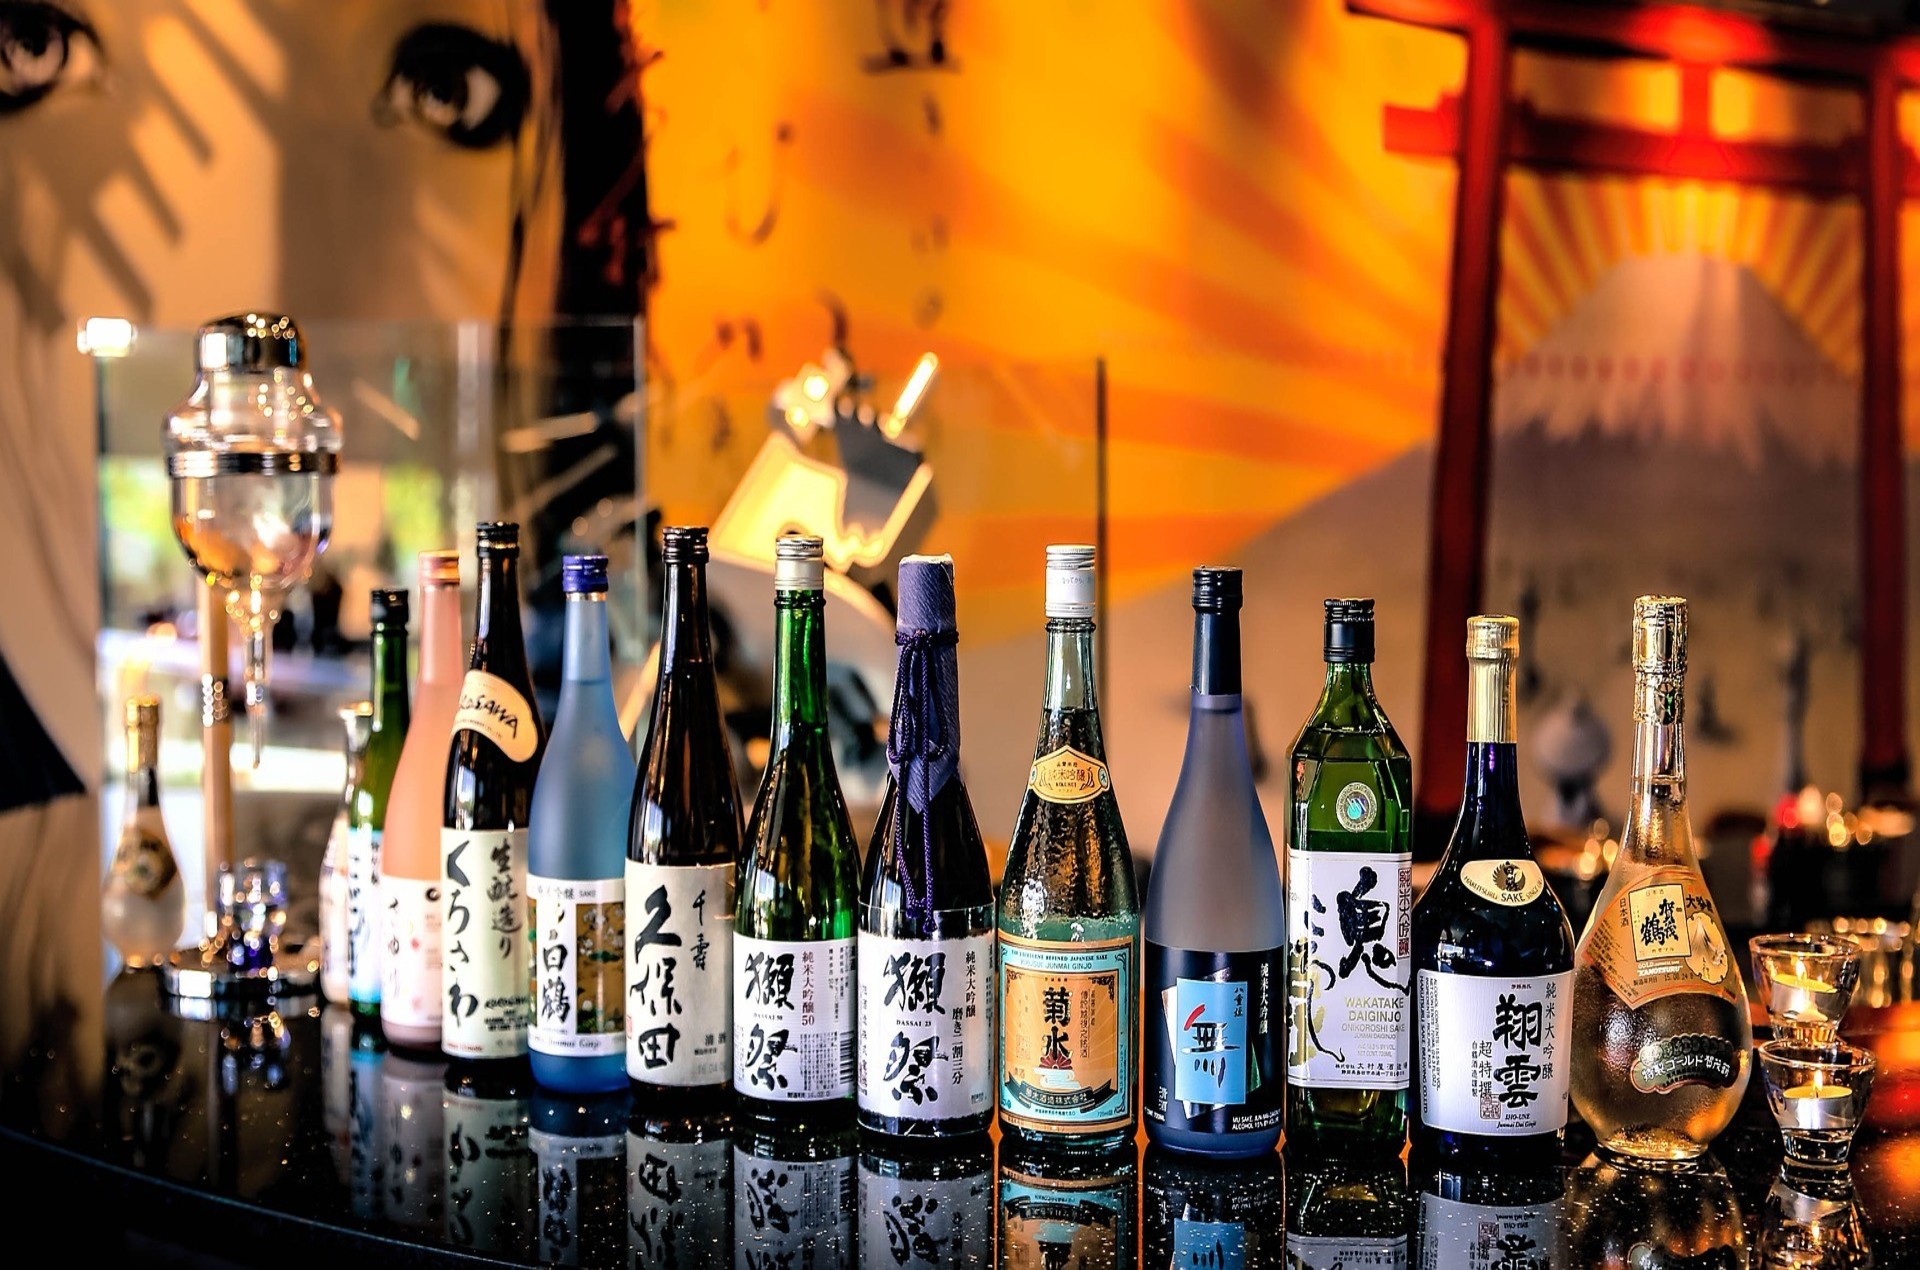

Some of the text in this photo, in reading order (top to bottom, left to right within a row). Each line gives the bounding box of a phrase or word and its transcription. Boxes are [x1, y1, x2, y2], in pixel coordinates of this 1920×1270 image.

[1501, 892, 1526, 903] SAKE
[1620, 898, 1629, 928] 日本酒
[446, 839, 479, 1028] くろさわ
[1046, 962, 1069, 970] JUNMAI
[1071, 962, 1092, 970] GINJO
[629, 884, 683, 1069] 久保田
[965, 951, 976, 1018] 純米大吟醸
[1345, 997, 1404, 1009] WAKATAKE
[883, 951, 949, 1106] 獺祭
[952, 1007, 964, 1085] 磨き二割三分
[1043, 987, 1072, 1060] 菊水
[1342, 1023, 1405, 1033] ONIKOROSHI SAKE
[1349, 1010, 1401, 1022] DAIGINJO
[1492, 993, 1542, 1109] 翔雲
[1542, 982, 1556, 1080] 純米大吟醸
